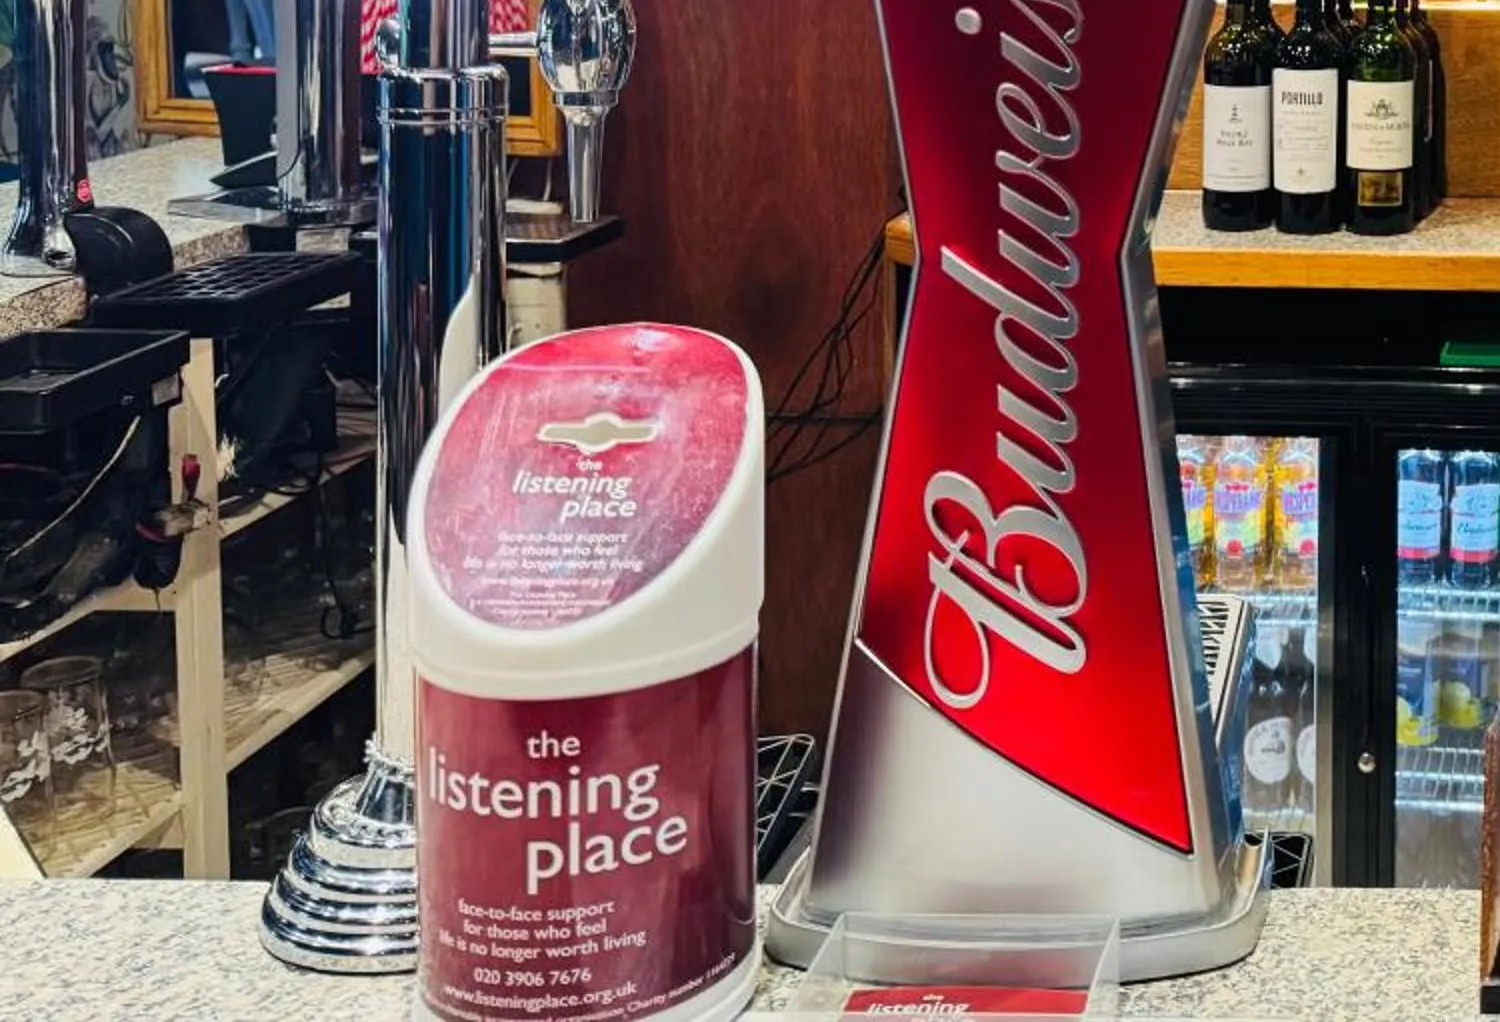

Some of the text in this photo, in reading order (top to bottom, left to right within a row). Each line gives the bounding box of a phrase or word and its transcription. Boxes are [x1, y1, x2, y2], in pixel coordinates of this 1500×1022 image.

[576, 458, 603, 472] the
[512, 468, 633, 499] listening
[558, 497, 637, 524] place
[527, 730, 581, 759] the
[428, 745, 661, 821] listening
[527, 815, 689, 896] place
[458, 898, 615, 924] face-to-face support
[463, 917, 608, 941] for those who feel
[456, 935, 467, 952] is
[469, 941, 488, 956] no
[491, 942, 541, 963] longer
[545, 939, 599, 959] worth
[602, 929, 648, 952] living
[473, 966, 593, 987] 020 3906 7676
[444, 981, 638, 1013] www.listeningplace.org.uk
